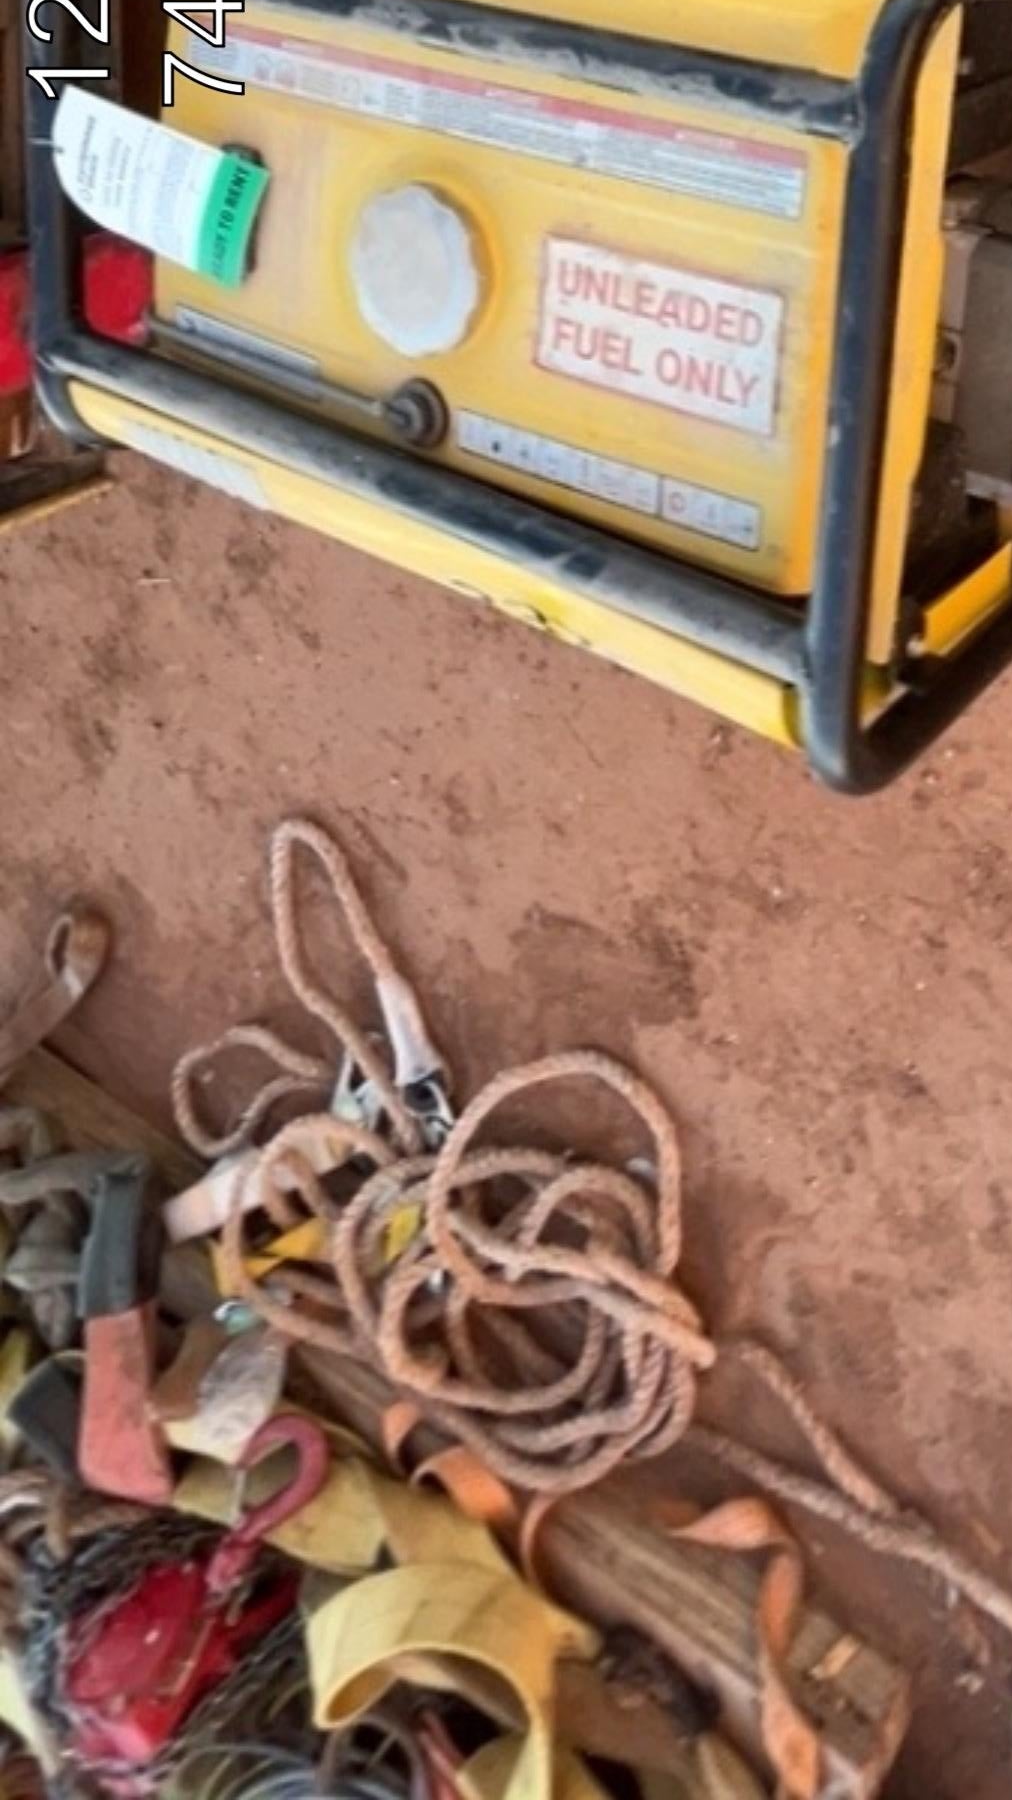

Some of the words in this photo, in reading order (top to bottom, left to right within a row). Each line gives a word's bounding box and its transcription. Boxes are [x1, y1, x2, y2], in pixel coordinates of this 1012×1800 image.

[557, 259, 763, 348] UNLEADED
[552, 316, 644, 376] FUEL
[655, 347, 761, 408] ONLY
